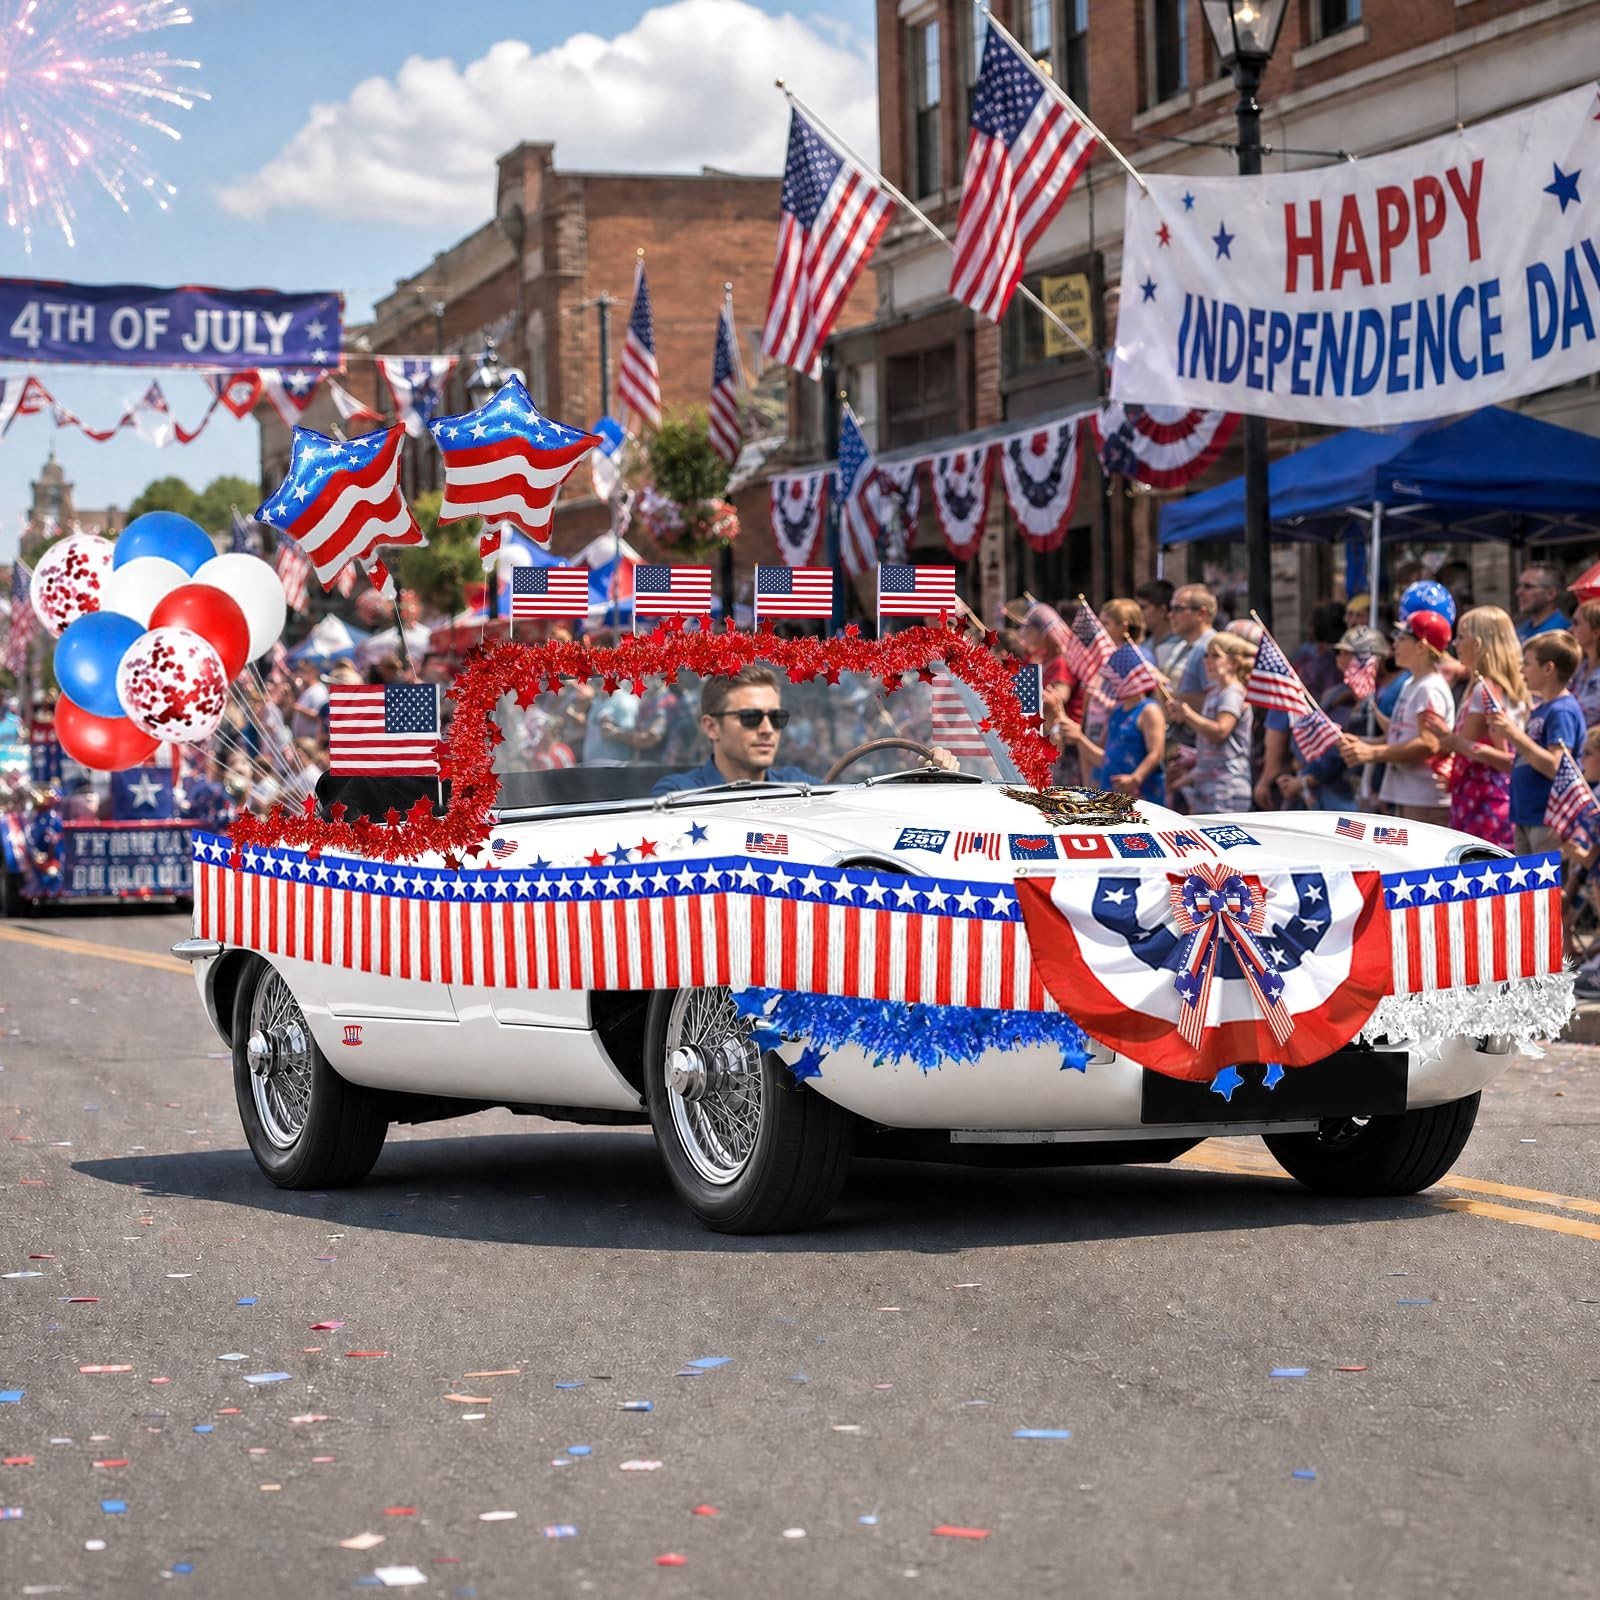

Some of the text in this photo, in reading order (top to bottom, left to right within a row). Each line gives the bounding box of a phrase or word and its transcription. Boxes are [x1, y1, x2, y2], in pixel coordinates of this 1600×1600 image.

[1284, 159, 1485, 293] HAPPY
[10, 301, 293, 355] 4TH OF JULY
[1177, 278, 1505, 397] INDEPENDENCE
[745, 831, 789, 855] USA
[900, 833, 945, 845] 250
[1209, 830, 1249, 842] 250
[1373, 826, 1408, 846] USA
